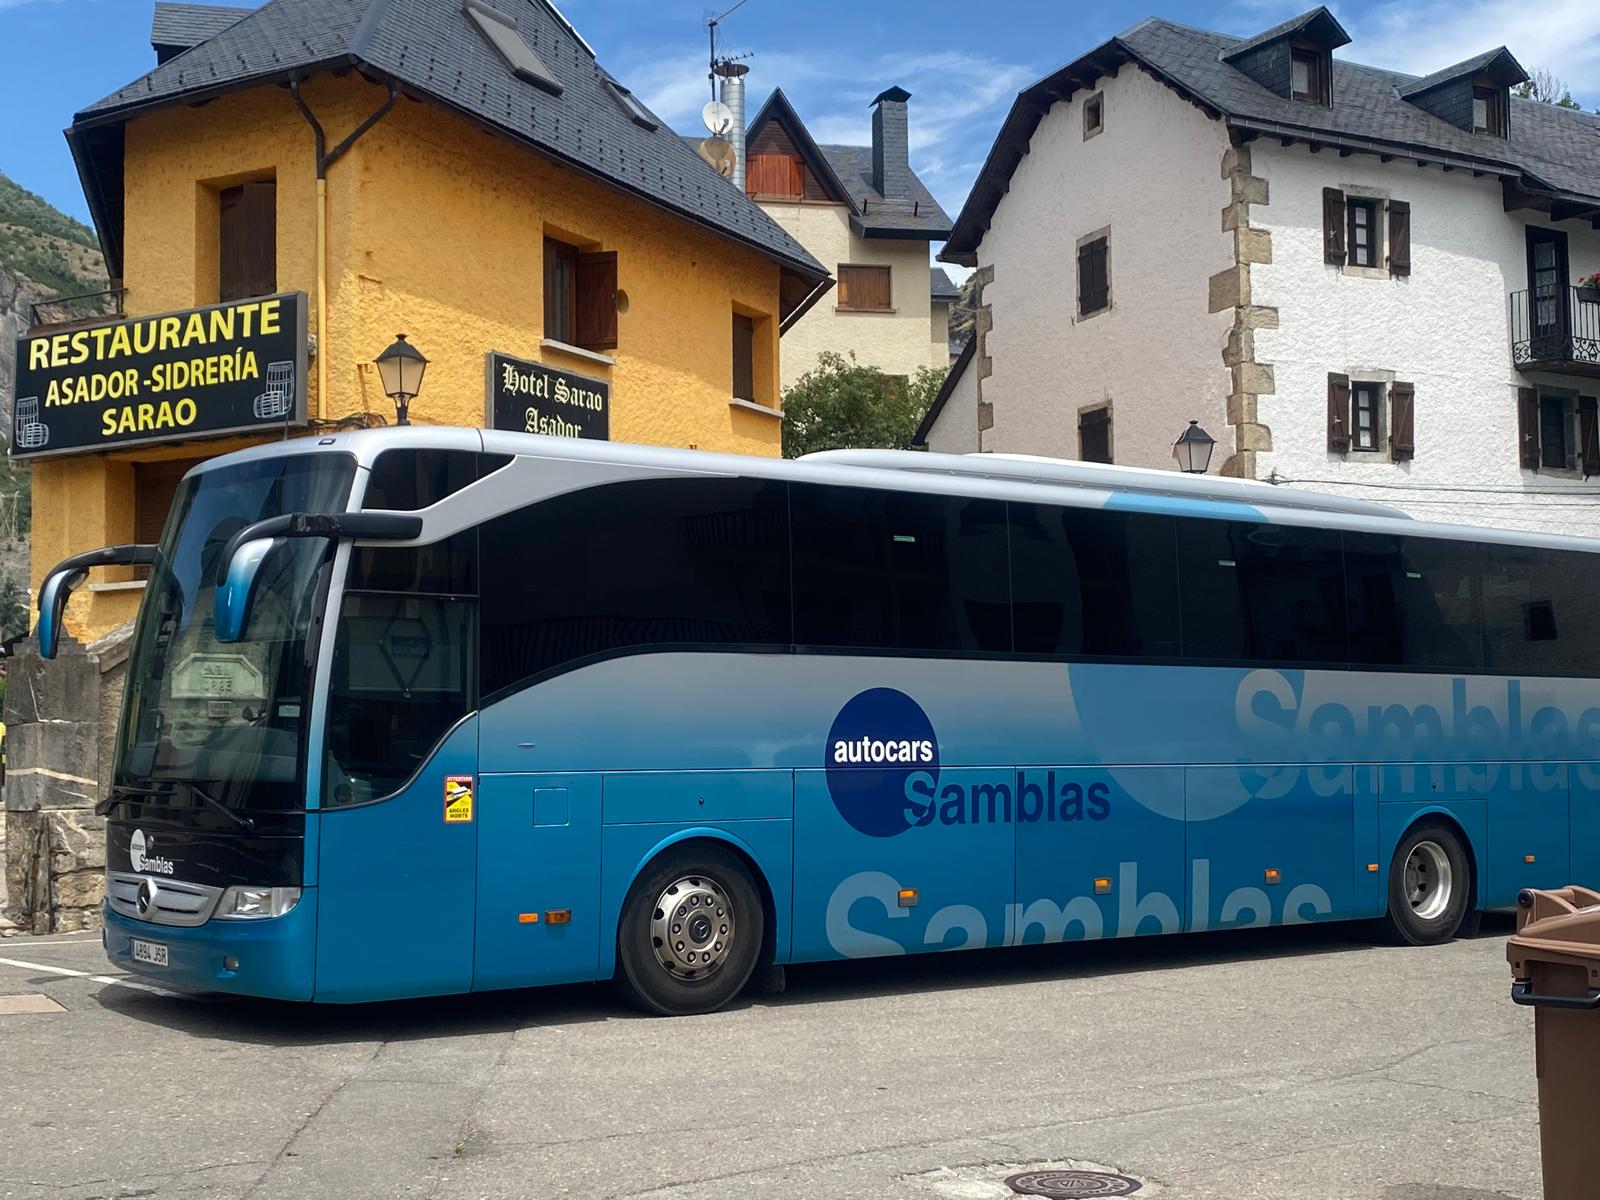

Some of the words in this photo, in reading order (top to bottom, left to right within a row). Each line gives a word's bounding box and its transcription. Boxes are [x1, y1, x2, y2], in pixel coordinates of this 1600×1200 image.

[29, 300, 280, 370] RESTAURANTE
[45, 369, 138, 407] ASADOR
[502, 363, 549, 399] Hotel
[554, 378, 602, 411] Sarao
[102, 398, 197, 436] SARAO
[525, 407, 582, 438] Asador
[834, 736, 933, 763] autocars
[904, 771, 1111, 827] Samblas
[140, 854, 174, 874] Samblas
